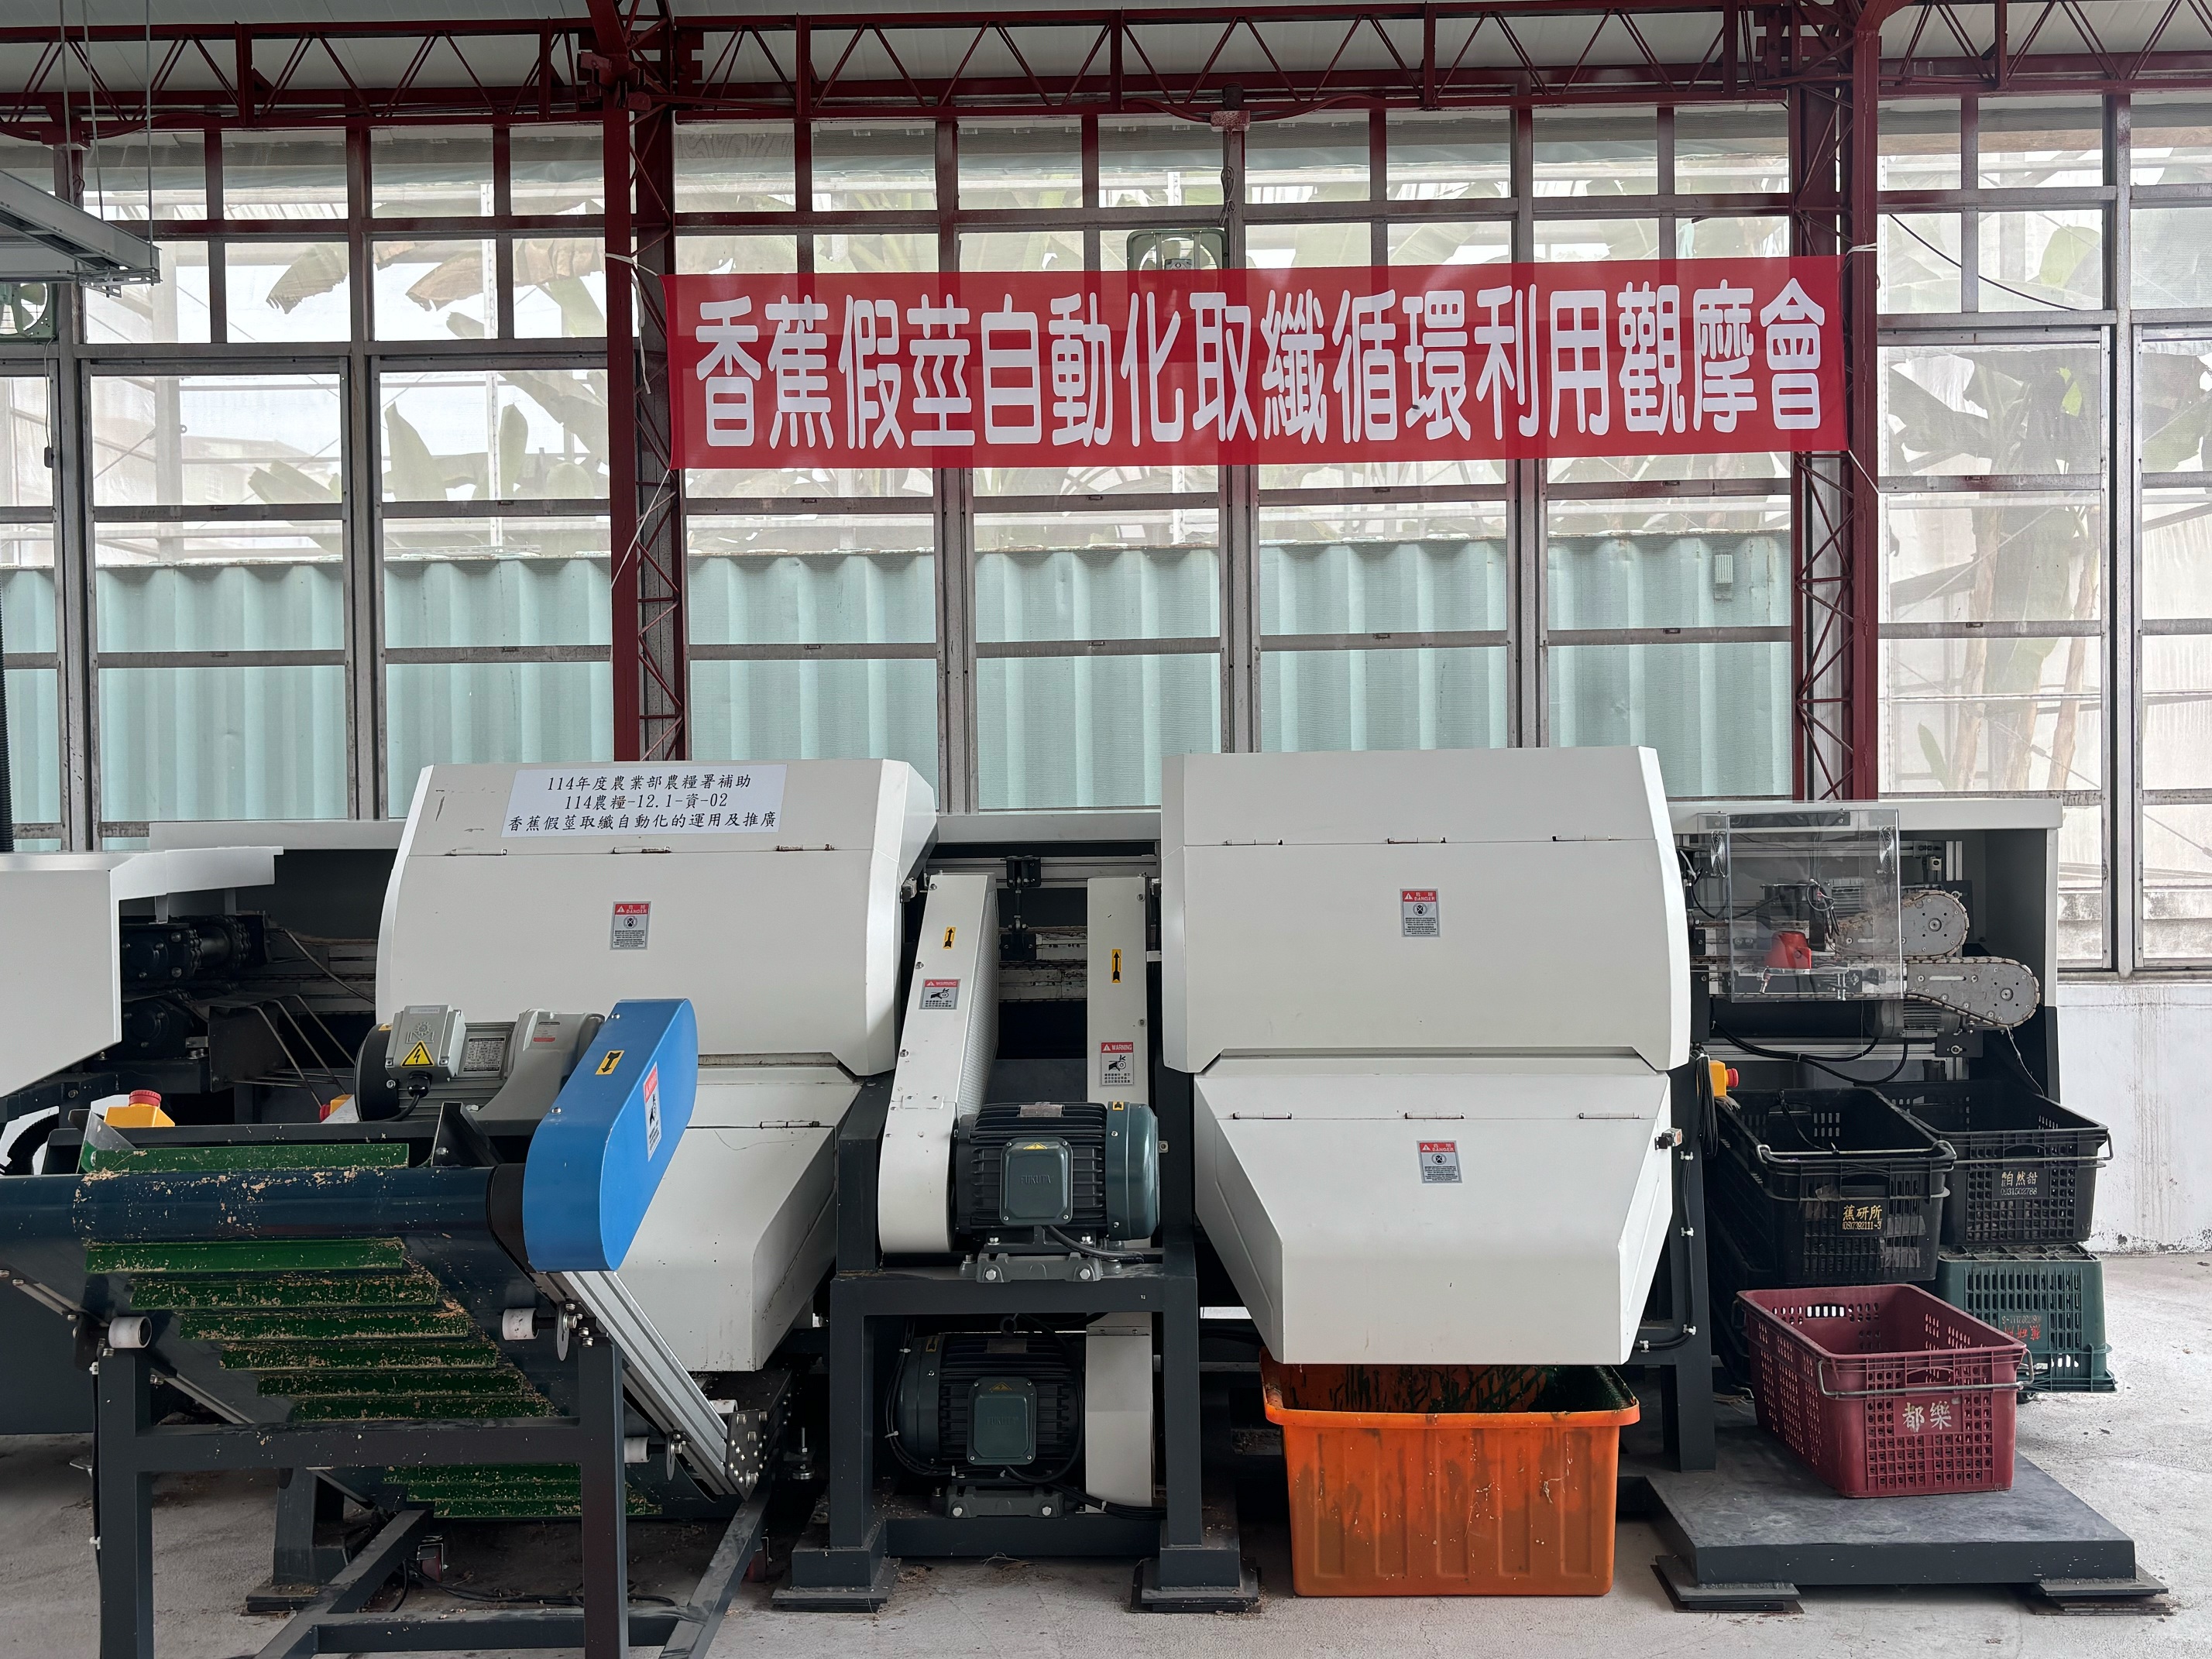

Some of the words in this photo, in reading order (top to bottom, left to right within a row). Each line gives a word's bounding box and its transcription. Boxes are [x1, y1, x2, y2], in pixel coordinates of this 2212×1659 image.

[695, 276, 1826, 449] 香蕉假莖自動化取纖循環利用觀摩會
[547, 774, 751, 792] 114年度農業部農糧署補助
[564, 792, 729, 811] 114農糧-12.1-資-02
[507, 811, 777, 832] 香蕉假莖取纖自動化的運用及推廣
[1843, 1204, 1883, 1221] 蕉研所
[1901, 1400, 1953, 1433] 都樂
